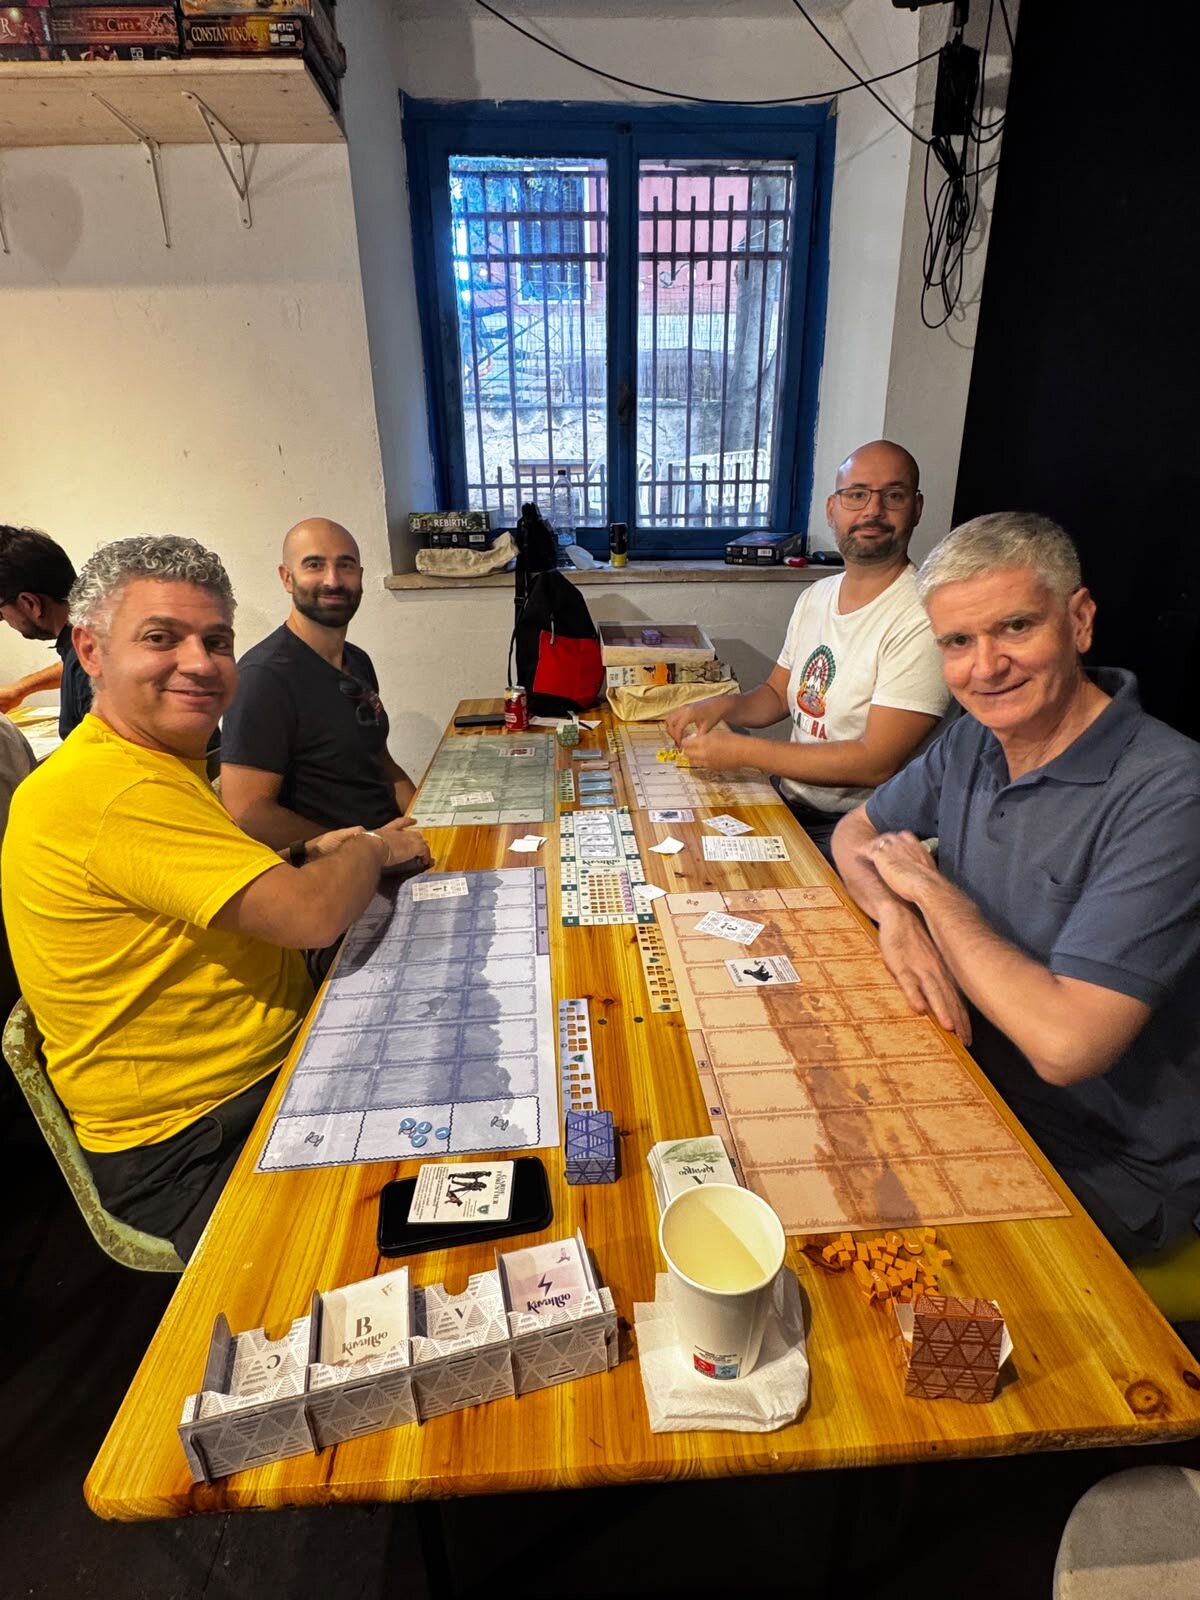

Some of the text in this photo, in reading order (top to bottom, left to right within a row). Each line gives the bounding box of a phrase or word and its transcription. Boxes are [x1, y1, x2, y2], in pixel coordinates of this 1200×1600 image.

[433, 518, 468, 527] REBIRTH
[526, 1291, 571, 1314] Kavango
[355, 1316, 373, 1338] B
[341, 1331, 388, 1356] Kavango
